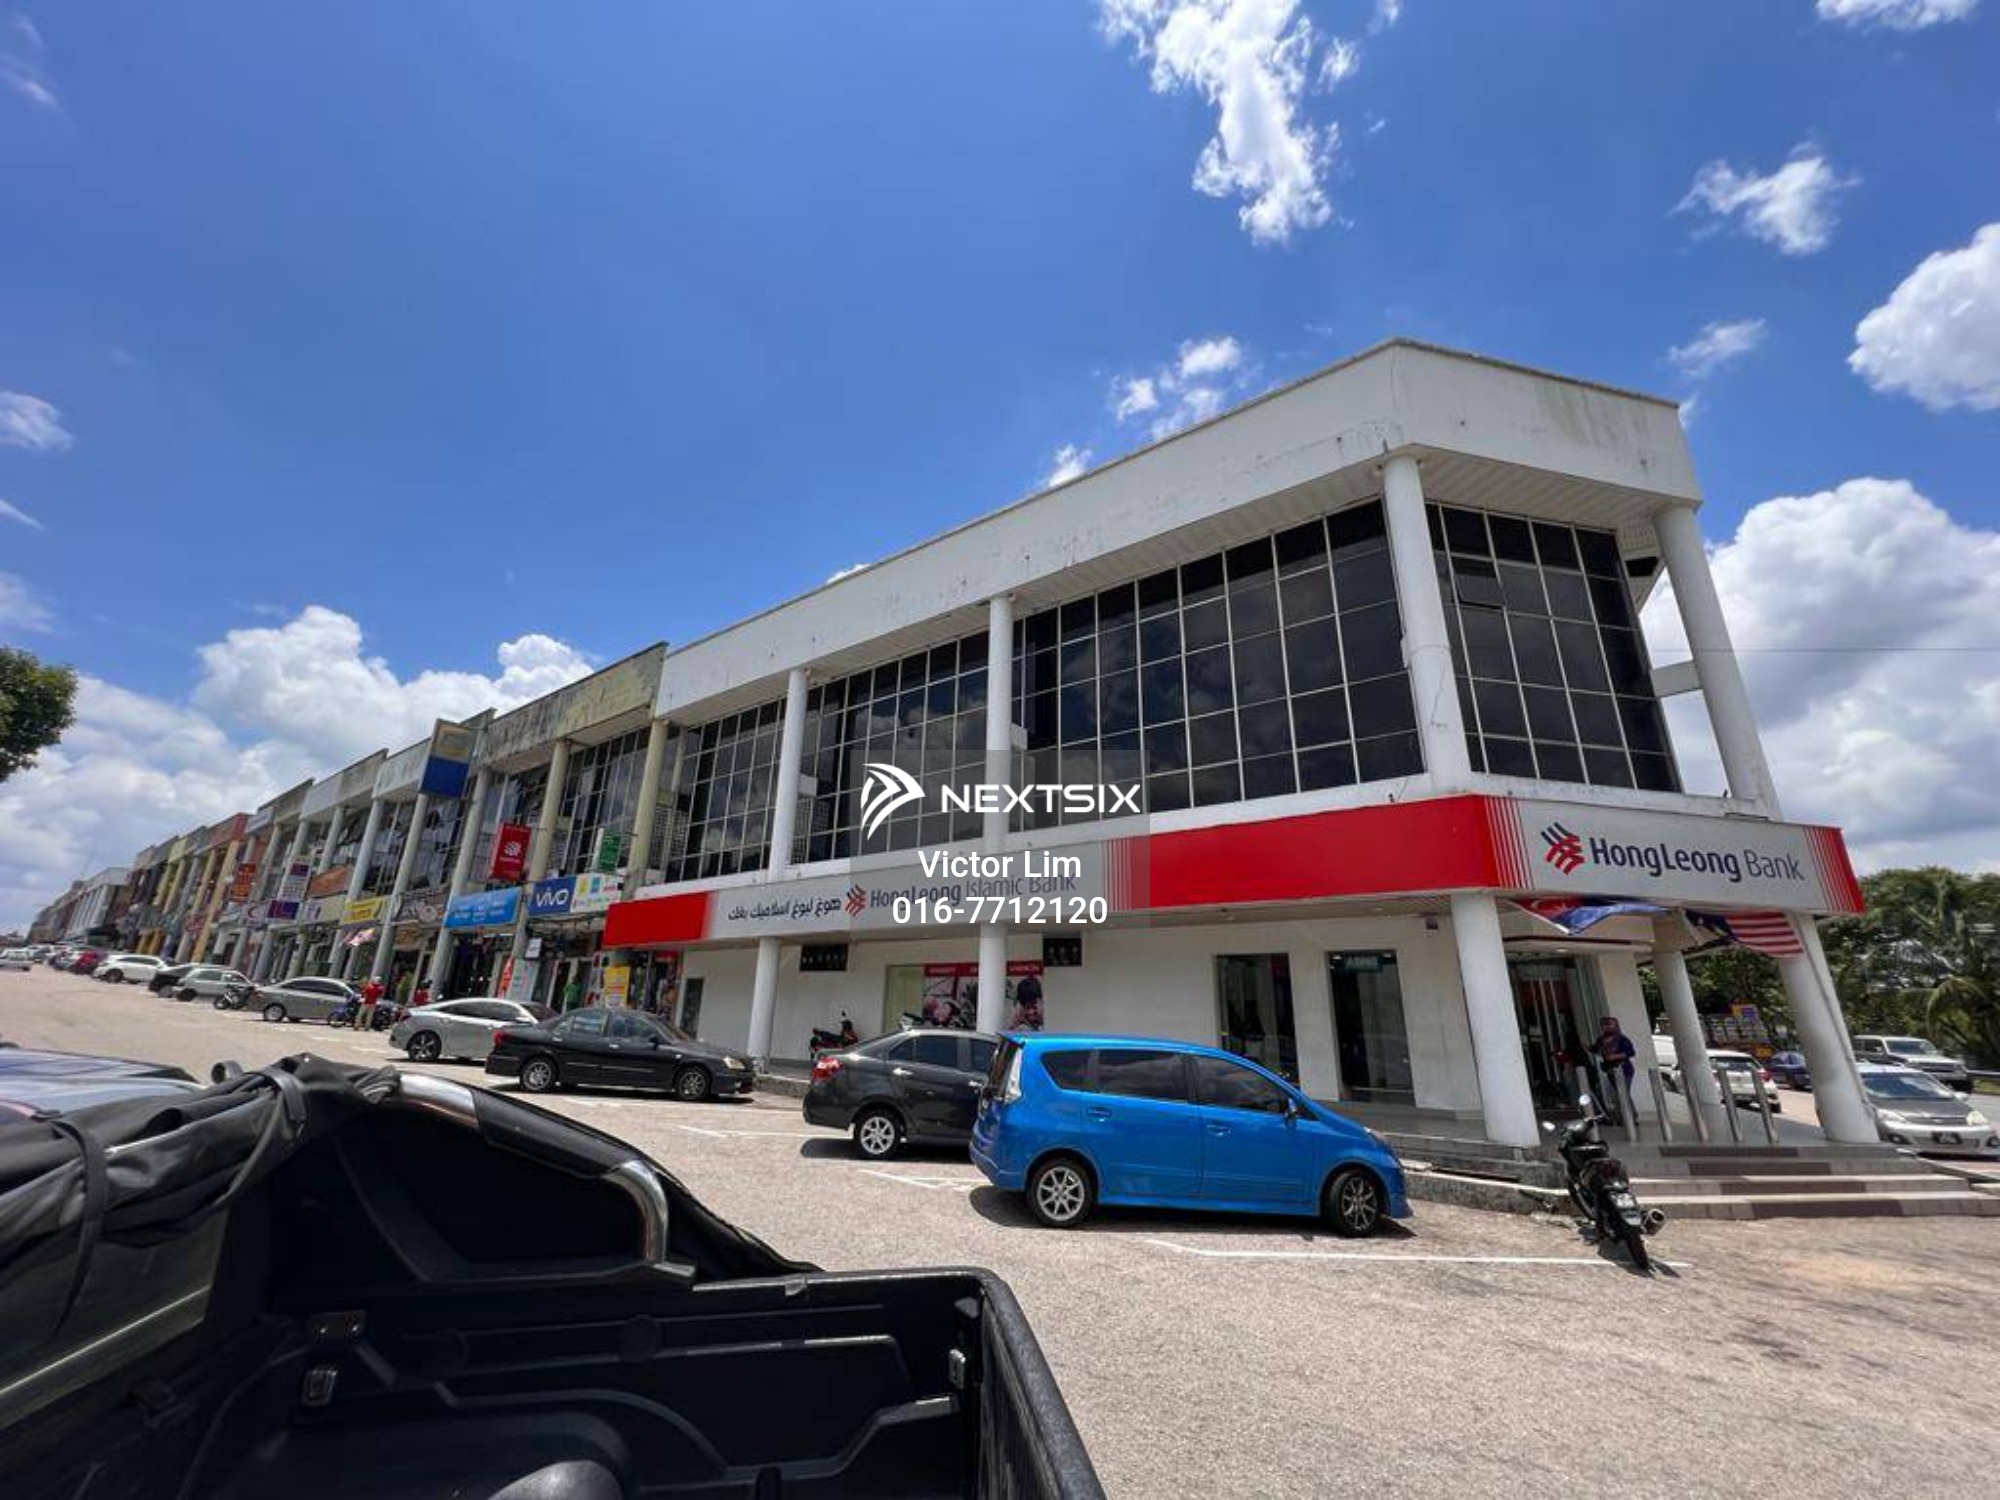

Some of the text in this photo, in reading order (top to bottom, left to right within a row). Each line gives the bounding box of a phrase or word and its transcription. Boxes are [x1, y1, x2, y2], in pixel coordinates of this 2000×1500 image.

[1588, 837, 1805, 883] HongLeong Bank
[965, 875, 1025, 899] Islamic
